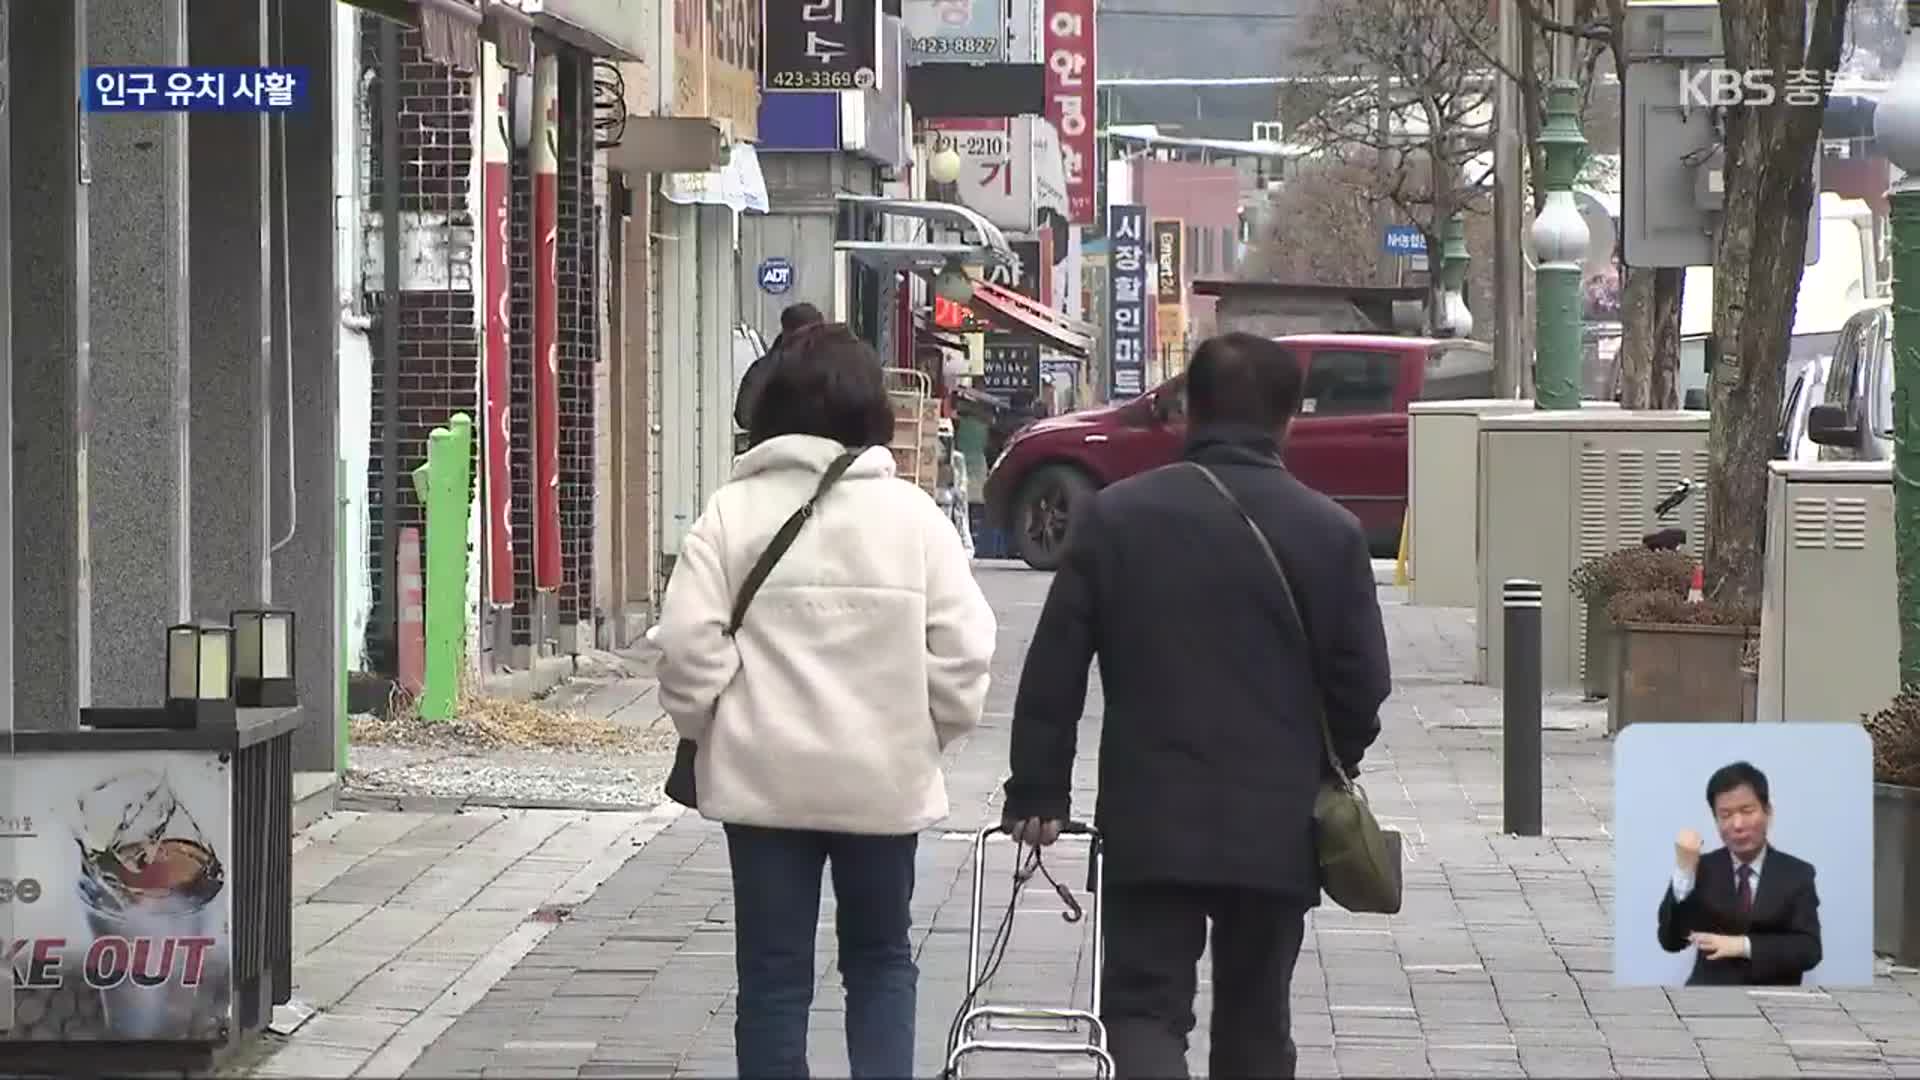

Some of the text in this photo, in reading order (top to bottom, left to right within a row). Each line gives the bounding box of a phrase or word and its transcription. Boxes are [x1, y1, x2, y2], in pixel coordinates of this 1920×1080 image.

[773, 71, 850, 87] 423-3369
[1050, 12, 1087, 184] 이안경원
[763, 268, 790, 282] ADT
[1114, 215, 1143, 394] 시장할인마트
[84, 936, 216, 989] OUT
